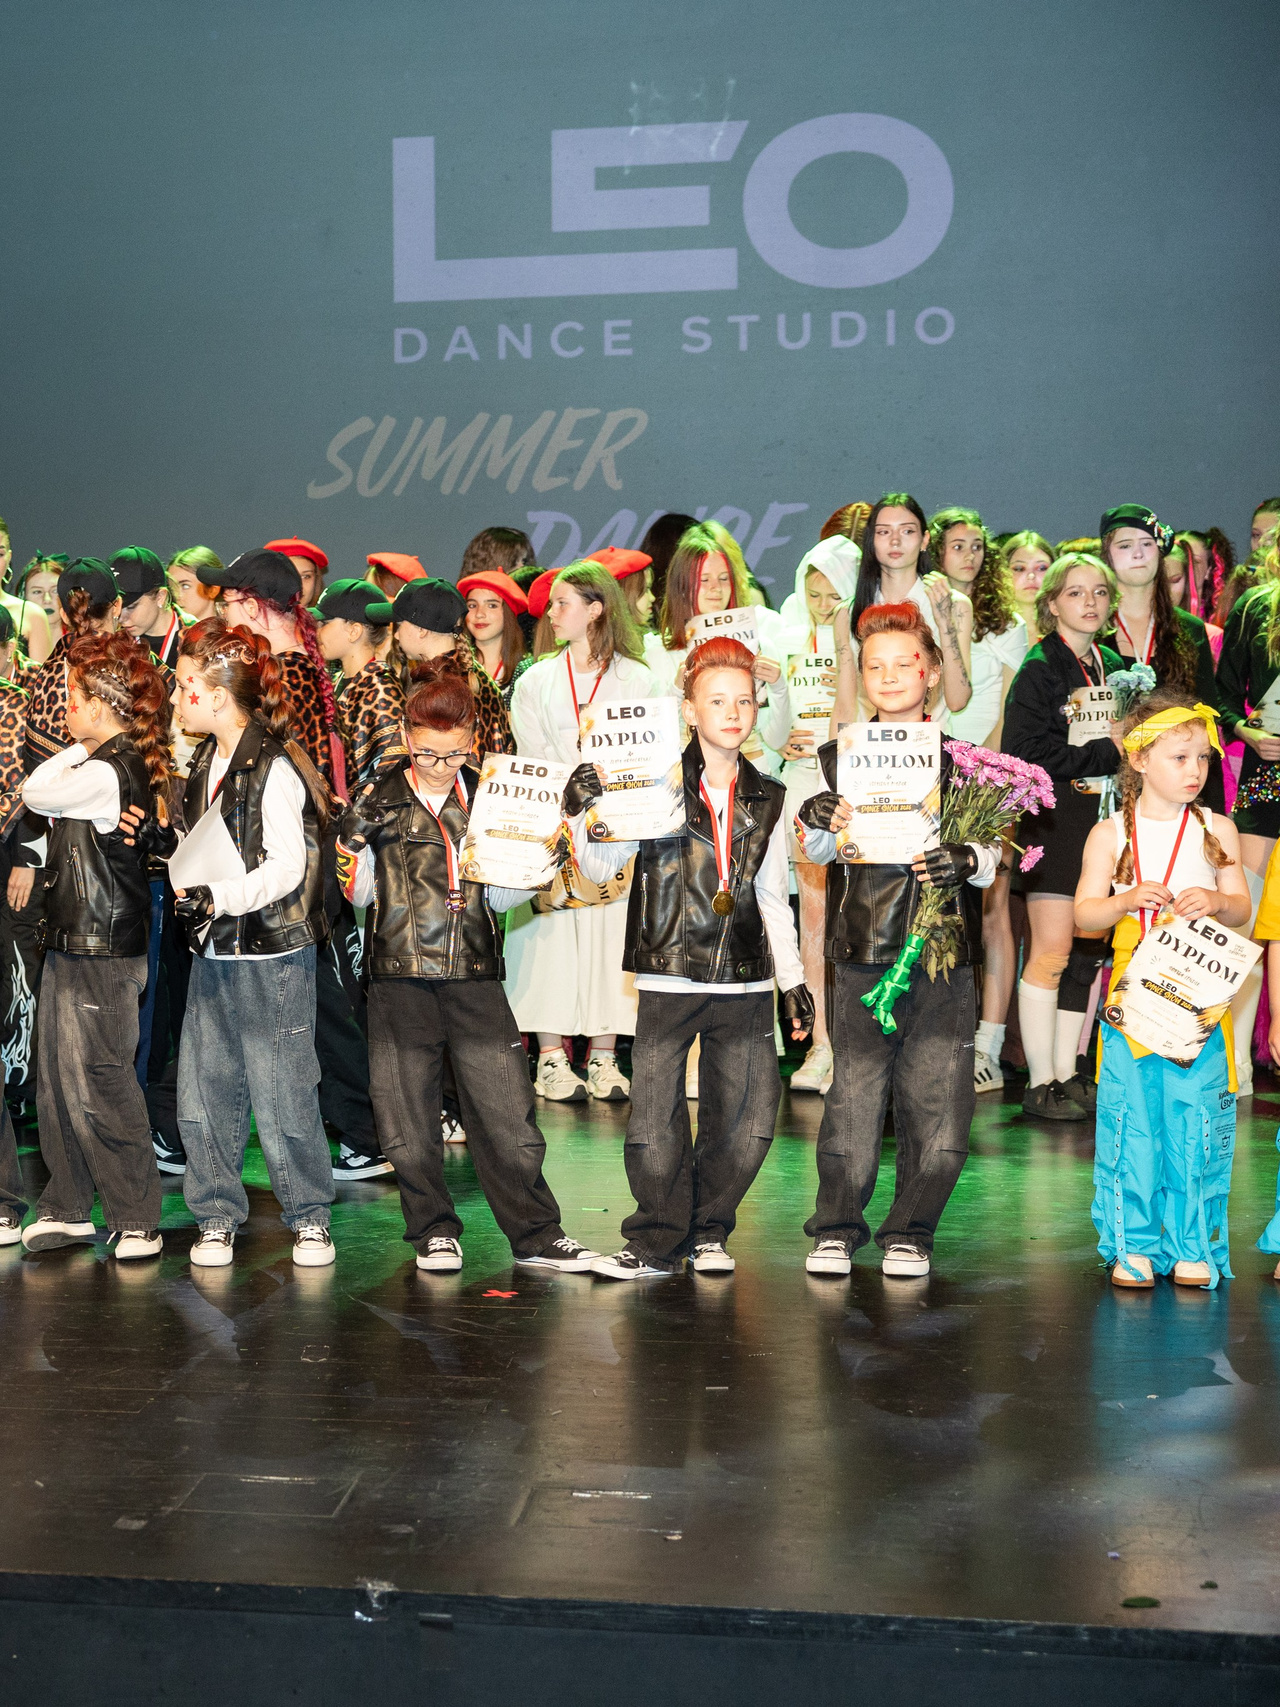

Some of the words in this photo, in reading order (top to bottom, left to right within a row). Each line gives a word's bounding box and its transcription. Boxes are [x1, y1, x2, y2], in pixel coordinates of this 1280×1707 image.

[392, 112, 954, 303] LEO
[393, 319, 634, 364] DANCE
[681, 306, 956, 354] STUDIO
[306, 407, 648, 499] SUMMER
[704, 615, 733, 628] LEO
[805, 658, 833, 667] LEO
[1090, 692, 1113, 702] LEO
[607, 706, 646, 720] LEO
[867, 729, 908, 742] LEO
[849, 755, 934, 768] DYPLOM
[510, 762, 548, 778] LEO
[1187, 919, 1228, 947] LEO
[1156, 929, 1240, 985] DYPLOM
[1160, 980, 1178, 993] LEO
